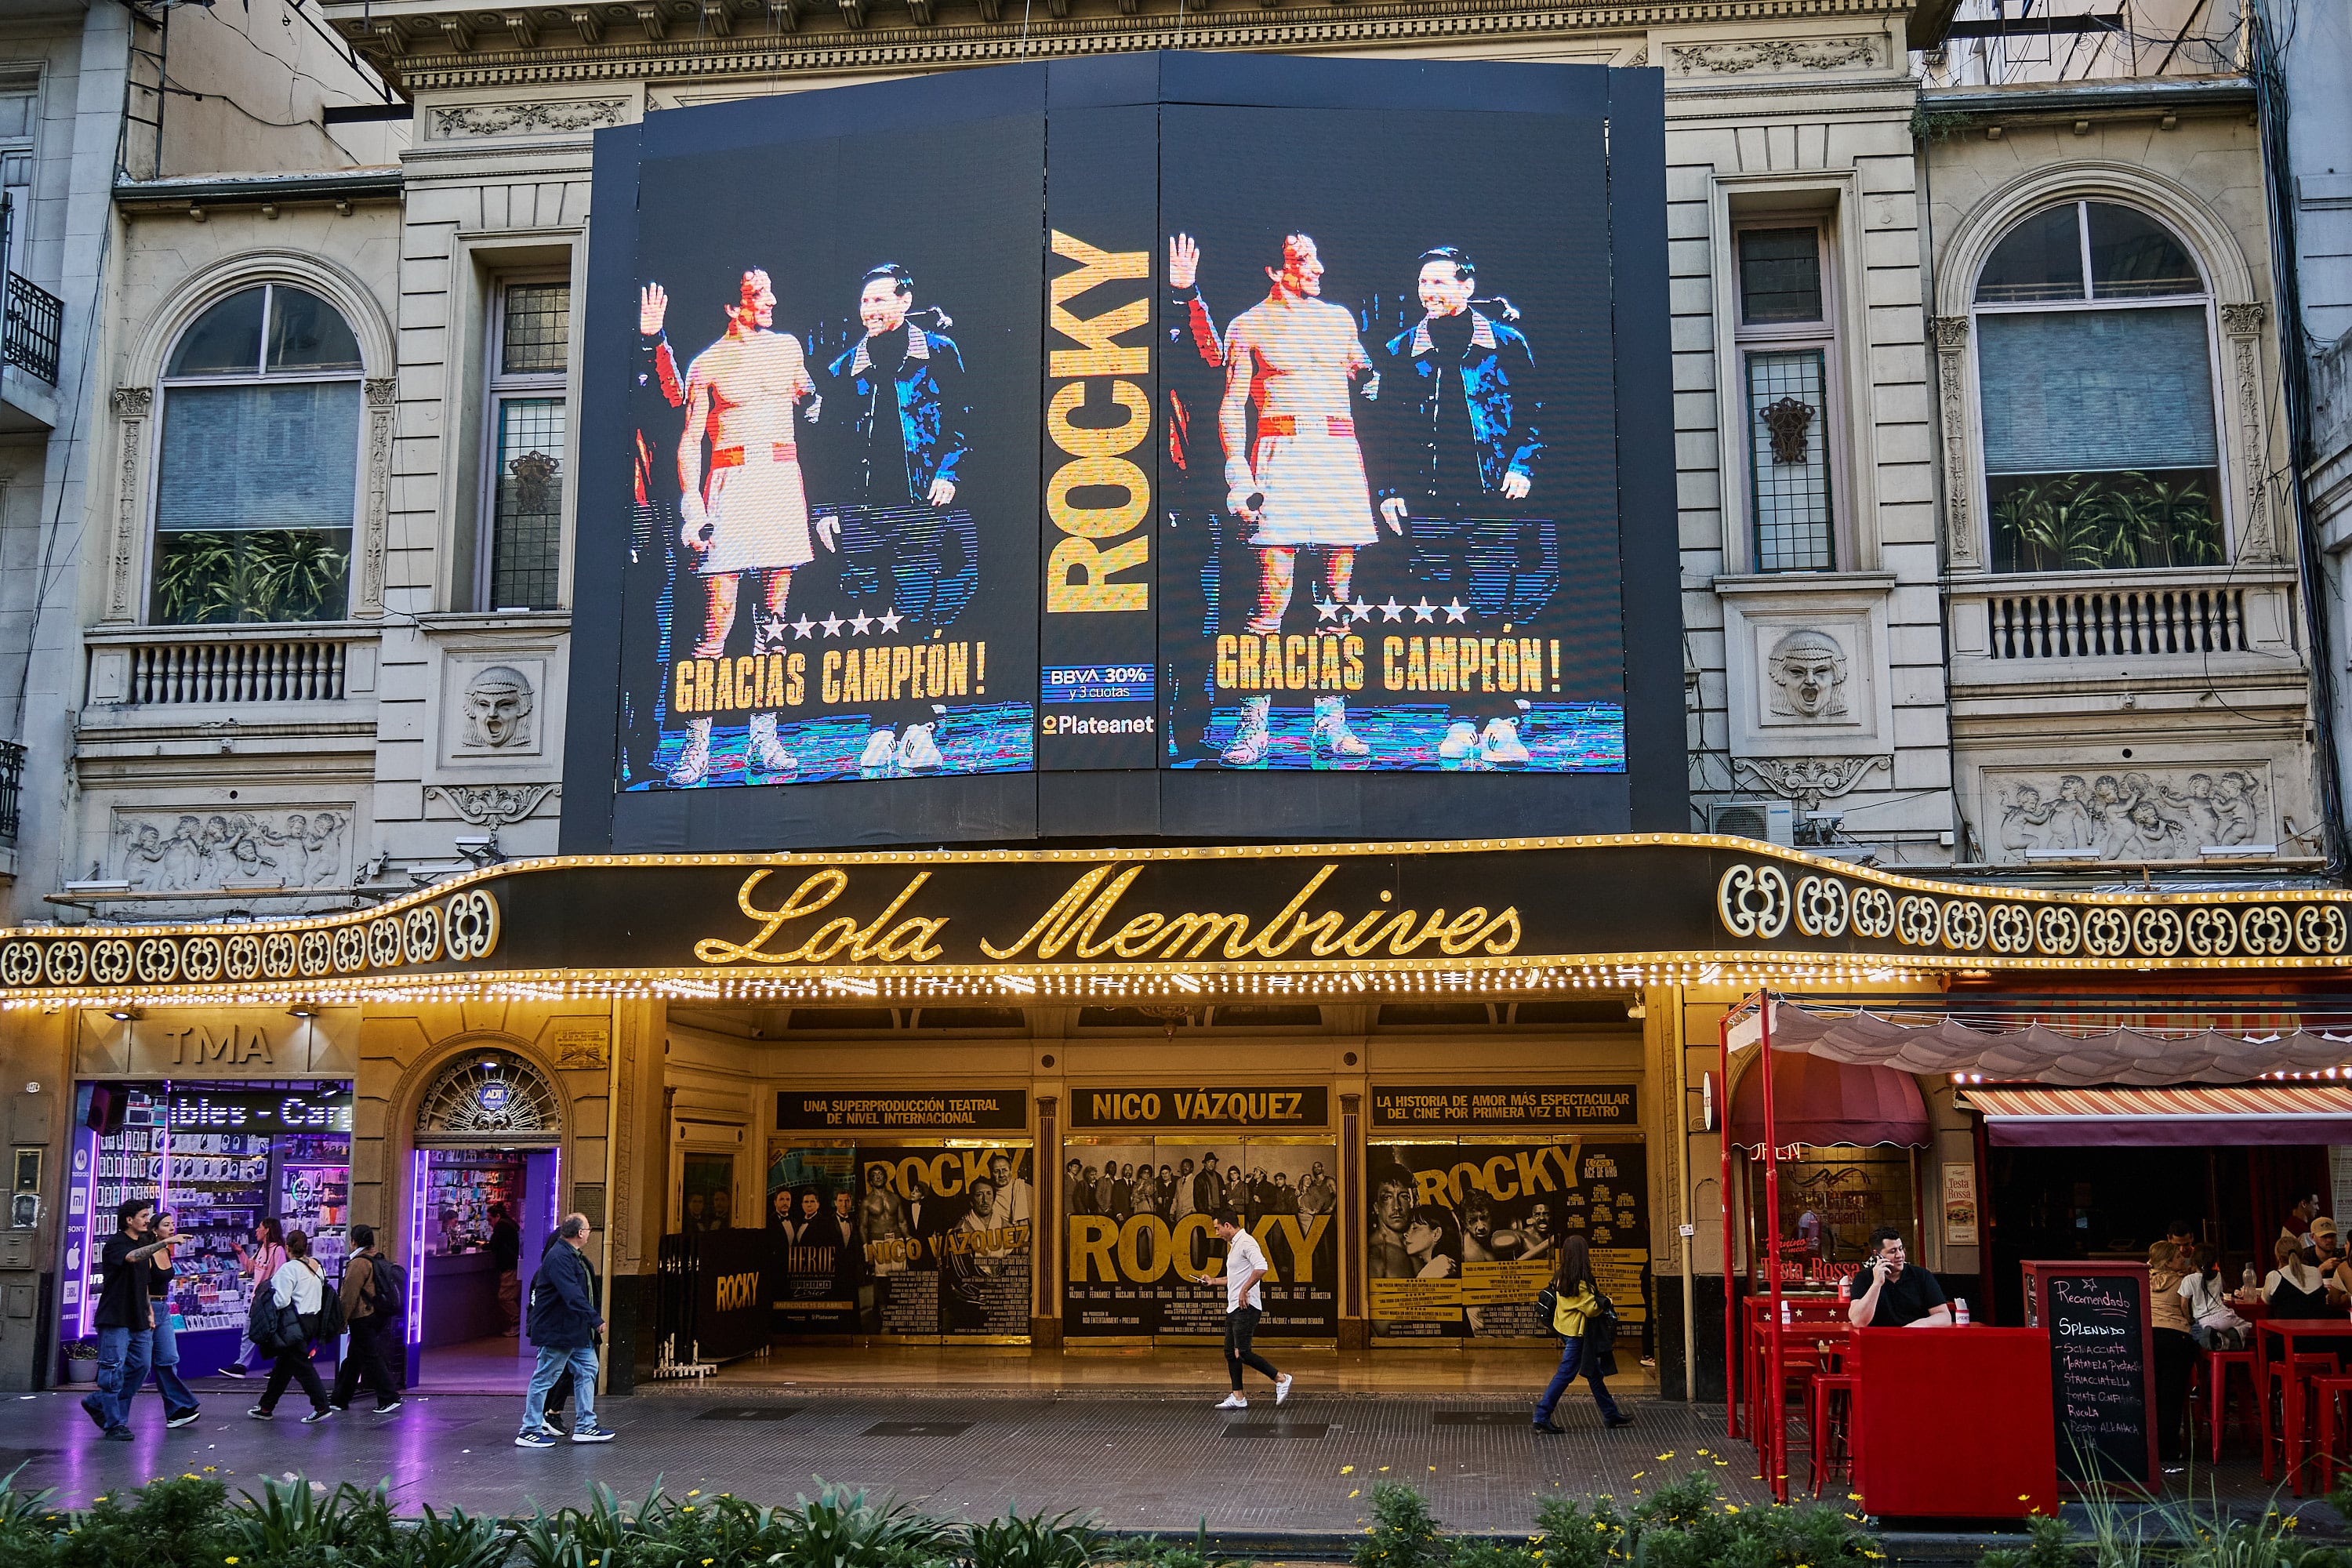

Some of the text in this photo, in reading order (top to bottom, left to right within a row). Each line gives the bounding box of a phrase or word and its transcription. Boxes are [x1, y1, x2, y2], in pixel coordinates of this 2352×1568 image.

[1046, 228, 1151, 613] ROCKY
[1215, 634, 1364, 691] GRACIAS
[675, 652, 805, 713] GRACIAS
[1051, 667, 1147, 685] BBVA 30%
[1069, 685, 1130, 700] y 3 cuotas
[1058, 714, 1155, 735] Plateanet
[692, 864, 1521, 962] Lola Membrives
[166, 1025, 272, 1063] TMA
[484, 1089, 503, 1099] ADT
[804, 1097, 1000, 1112] UNA SUPERPRODUCCIÓN TEATRAL
[1092, 1087, 1302, 1124] NICO VÁZQUEZ
[1377, 1091, 1629, 1108] LA HISTORIA DE AMOR MÁS ESPECTACULAR
[826, 1111, 976, 1125] DE NIVEL INTERNACIONAL
[1387, 1105, 1619, 1120] DEL CINE POR PRIMERA VEZ EN TEATRO
[863, 1148, 1026, 1200] ROCKY
[1413, 1143, 1581, 1210] ROCKY
[1584, 1166, 1617, 1178] ACE DE ORO
[1948, 1178, 1969, 1189] Testa
[868, 1225, 1031, 1265] NICO VÁZQUEZ
[1069, 1213, 1331, 1283] ROCKY
[788, 1246, 836, 1272] HEROE
[1761, 1257, 1860, 1280] Tsta Rossa
[67, 1287, 77, 1298] JBL
[717, 1271, 759, 1312] ROCKY
[2053, 1280, 2130, 1308] Recomendado
